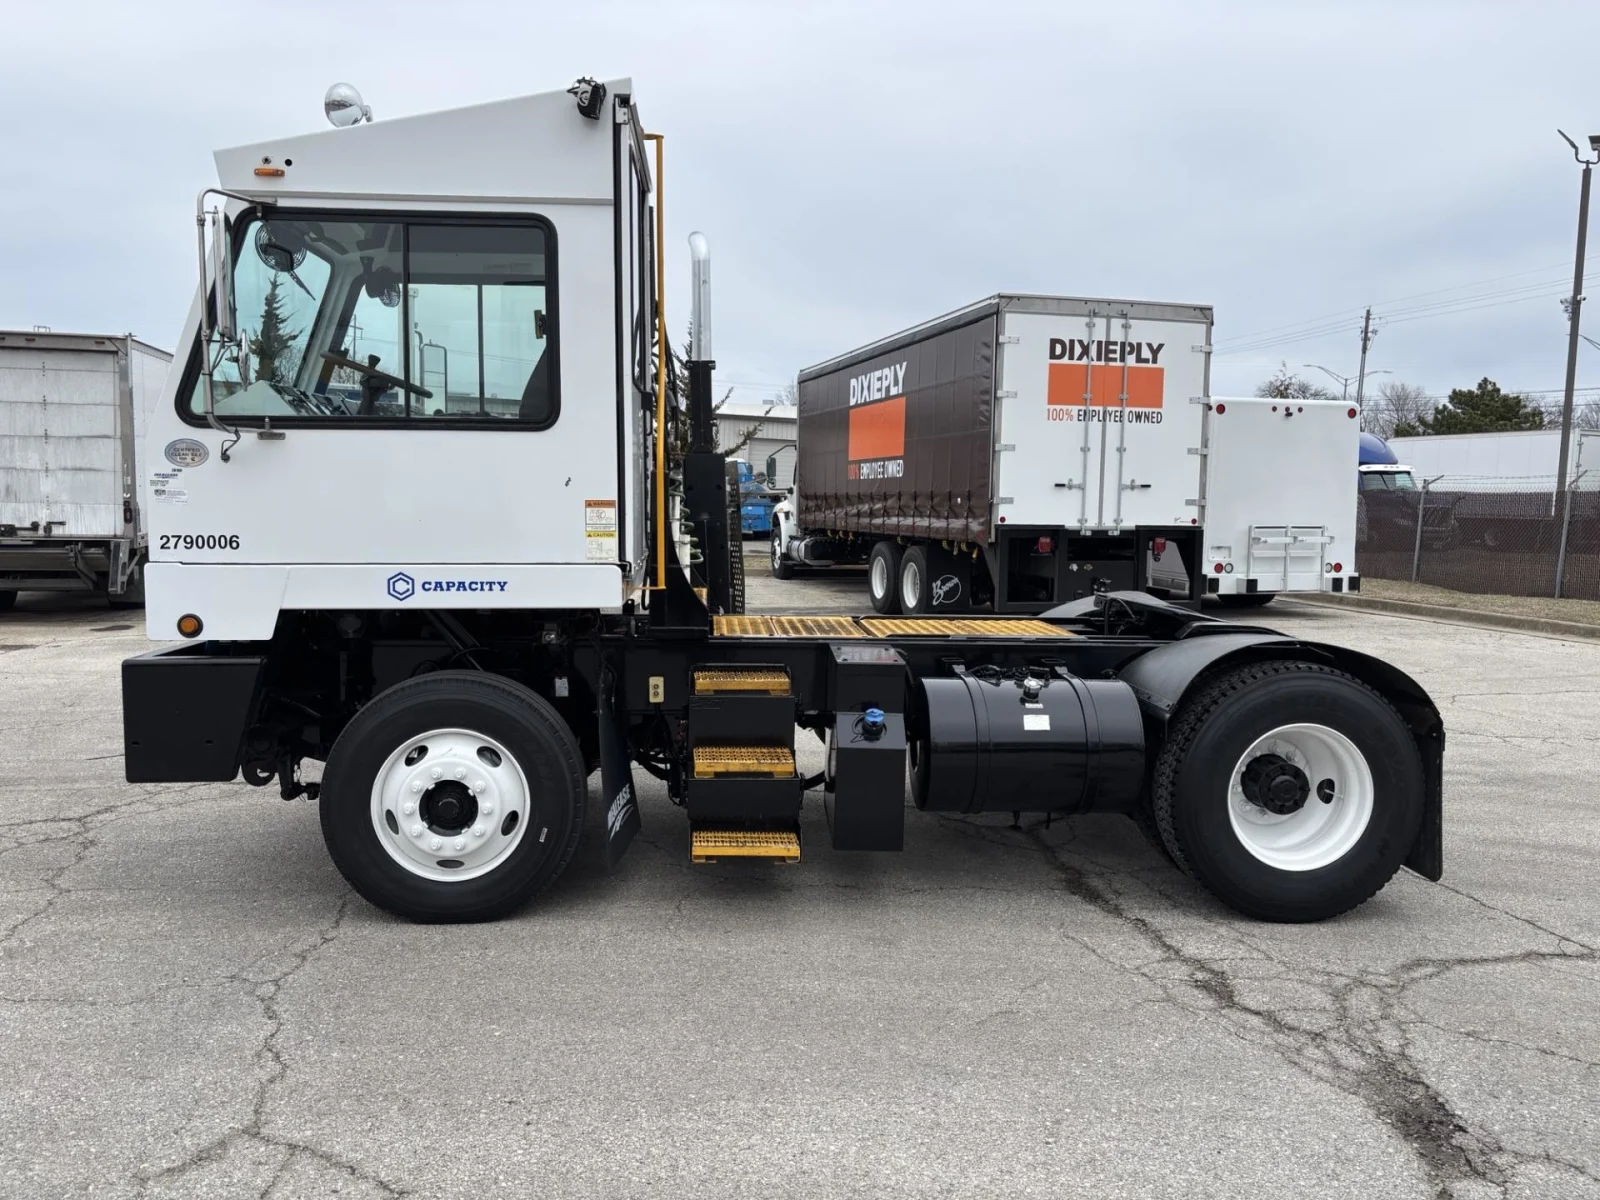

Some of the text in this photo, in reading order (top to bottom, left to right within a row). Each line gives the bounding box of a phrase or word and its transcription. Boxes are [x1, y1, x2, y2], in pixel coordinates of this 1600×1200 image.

[1049, 338, 1165, 364] DIXIEPLY
[849, 361, 908, 406] DIXIEPLY
[1047, 408, 1074, 421] 100%
[1127, 410, 1163, 424] OWNED
[159, 534, 240, 550] 2790006
[421, 581, 508, 592] CAPACITY
